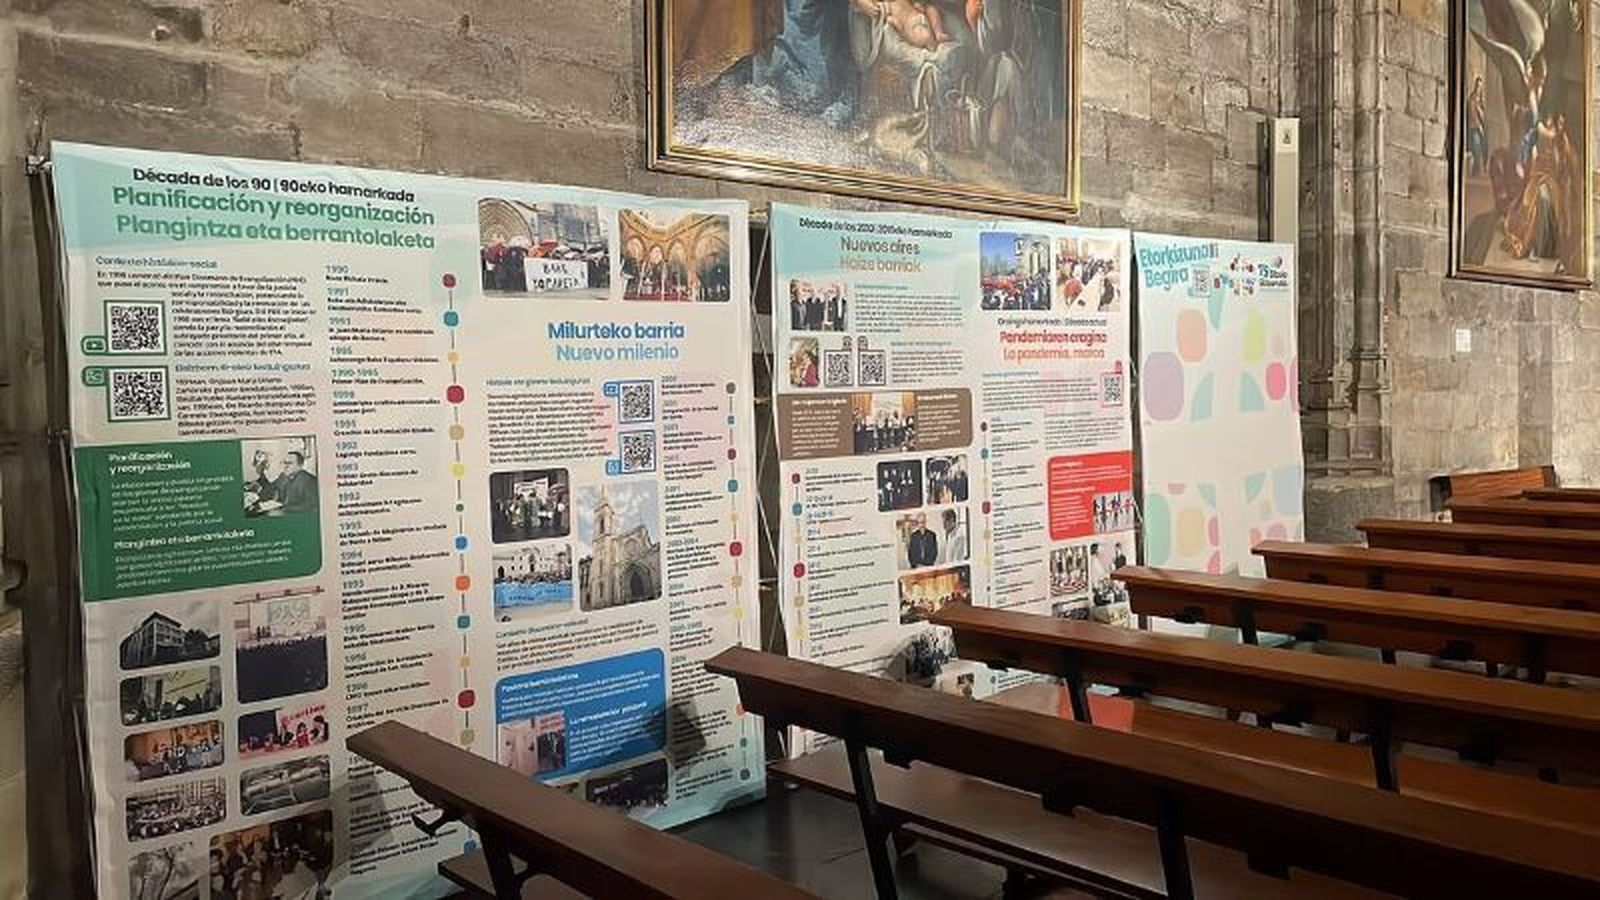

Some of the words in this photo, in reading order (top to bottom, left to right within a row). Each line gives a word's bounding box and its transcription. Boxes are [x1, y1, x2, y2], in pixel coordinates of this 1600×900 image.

[133, 168, 200, 184] Década
[203, 173, 224, 187] de
[251, 178, 271, 190] 90
[329, 181, 415, 202] hamarkada
[113, 186, 265, 214] Planificación
[268, 200, 281, 220] y
[285, 202, 435, 225] reorganización
[117, 214, 242, 241] Plangintza
[246, 222, 282, 240] eta
[286, 224, 435, 249] berrantolaketa
[840, 236, 889, 252] Nuevos
[889, 239, 921, 255] aires
[1144, 268, 1188, 290] Begira
[548, 320, 632, 339] Milurteko
[635, 321, 685, 339] barria
[1000, 329, 1068, 343] Pandemiaren
[557, 345, 615, 361] Nuevo
[617, 342, 679, 360] milenio
